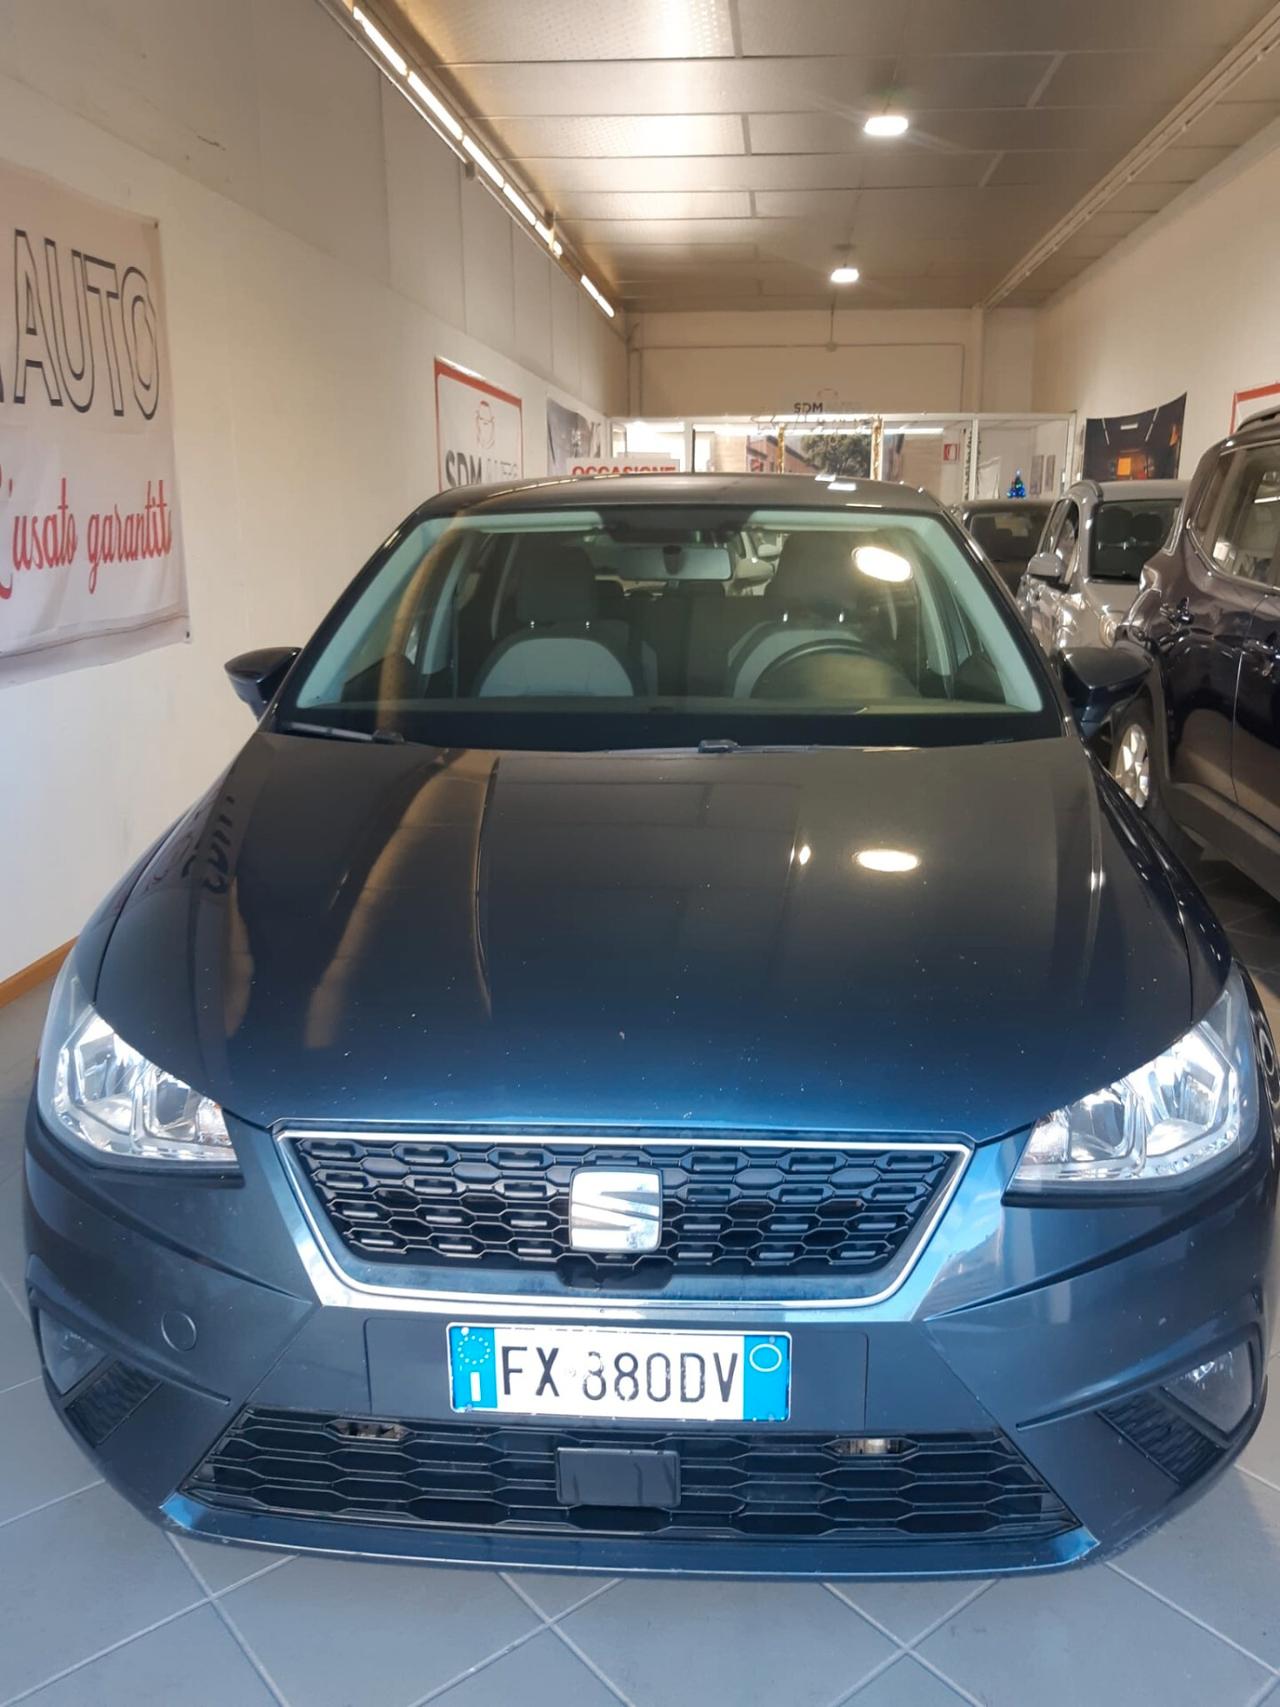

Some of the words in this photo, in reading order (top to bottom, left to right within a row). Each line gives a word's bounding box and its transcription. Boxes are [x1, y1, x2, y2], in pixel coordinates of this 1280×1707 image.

[14, 228, 160, 420] AUTO
[794, 402, 823, 414] SDM
[501, 1346, 560, 1397] FX
